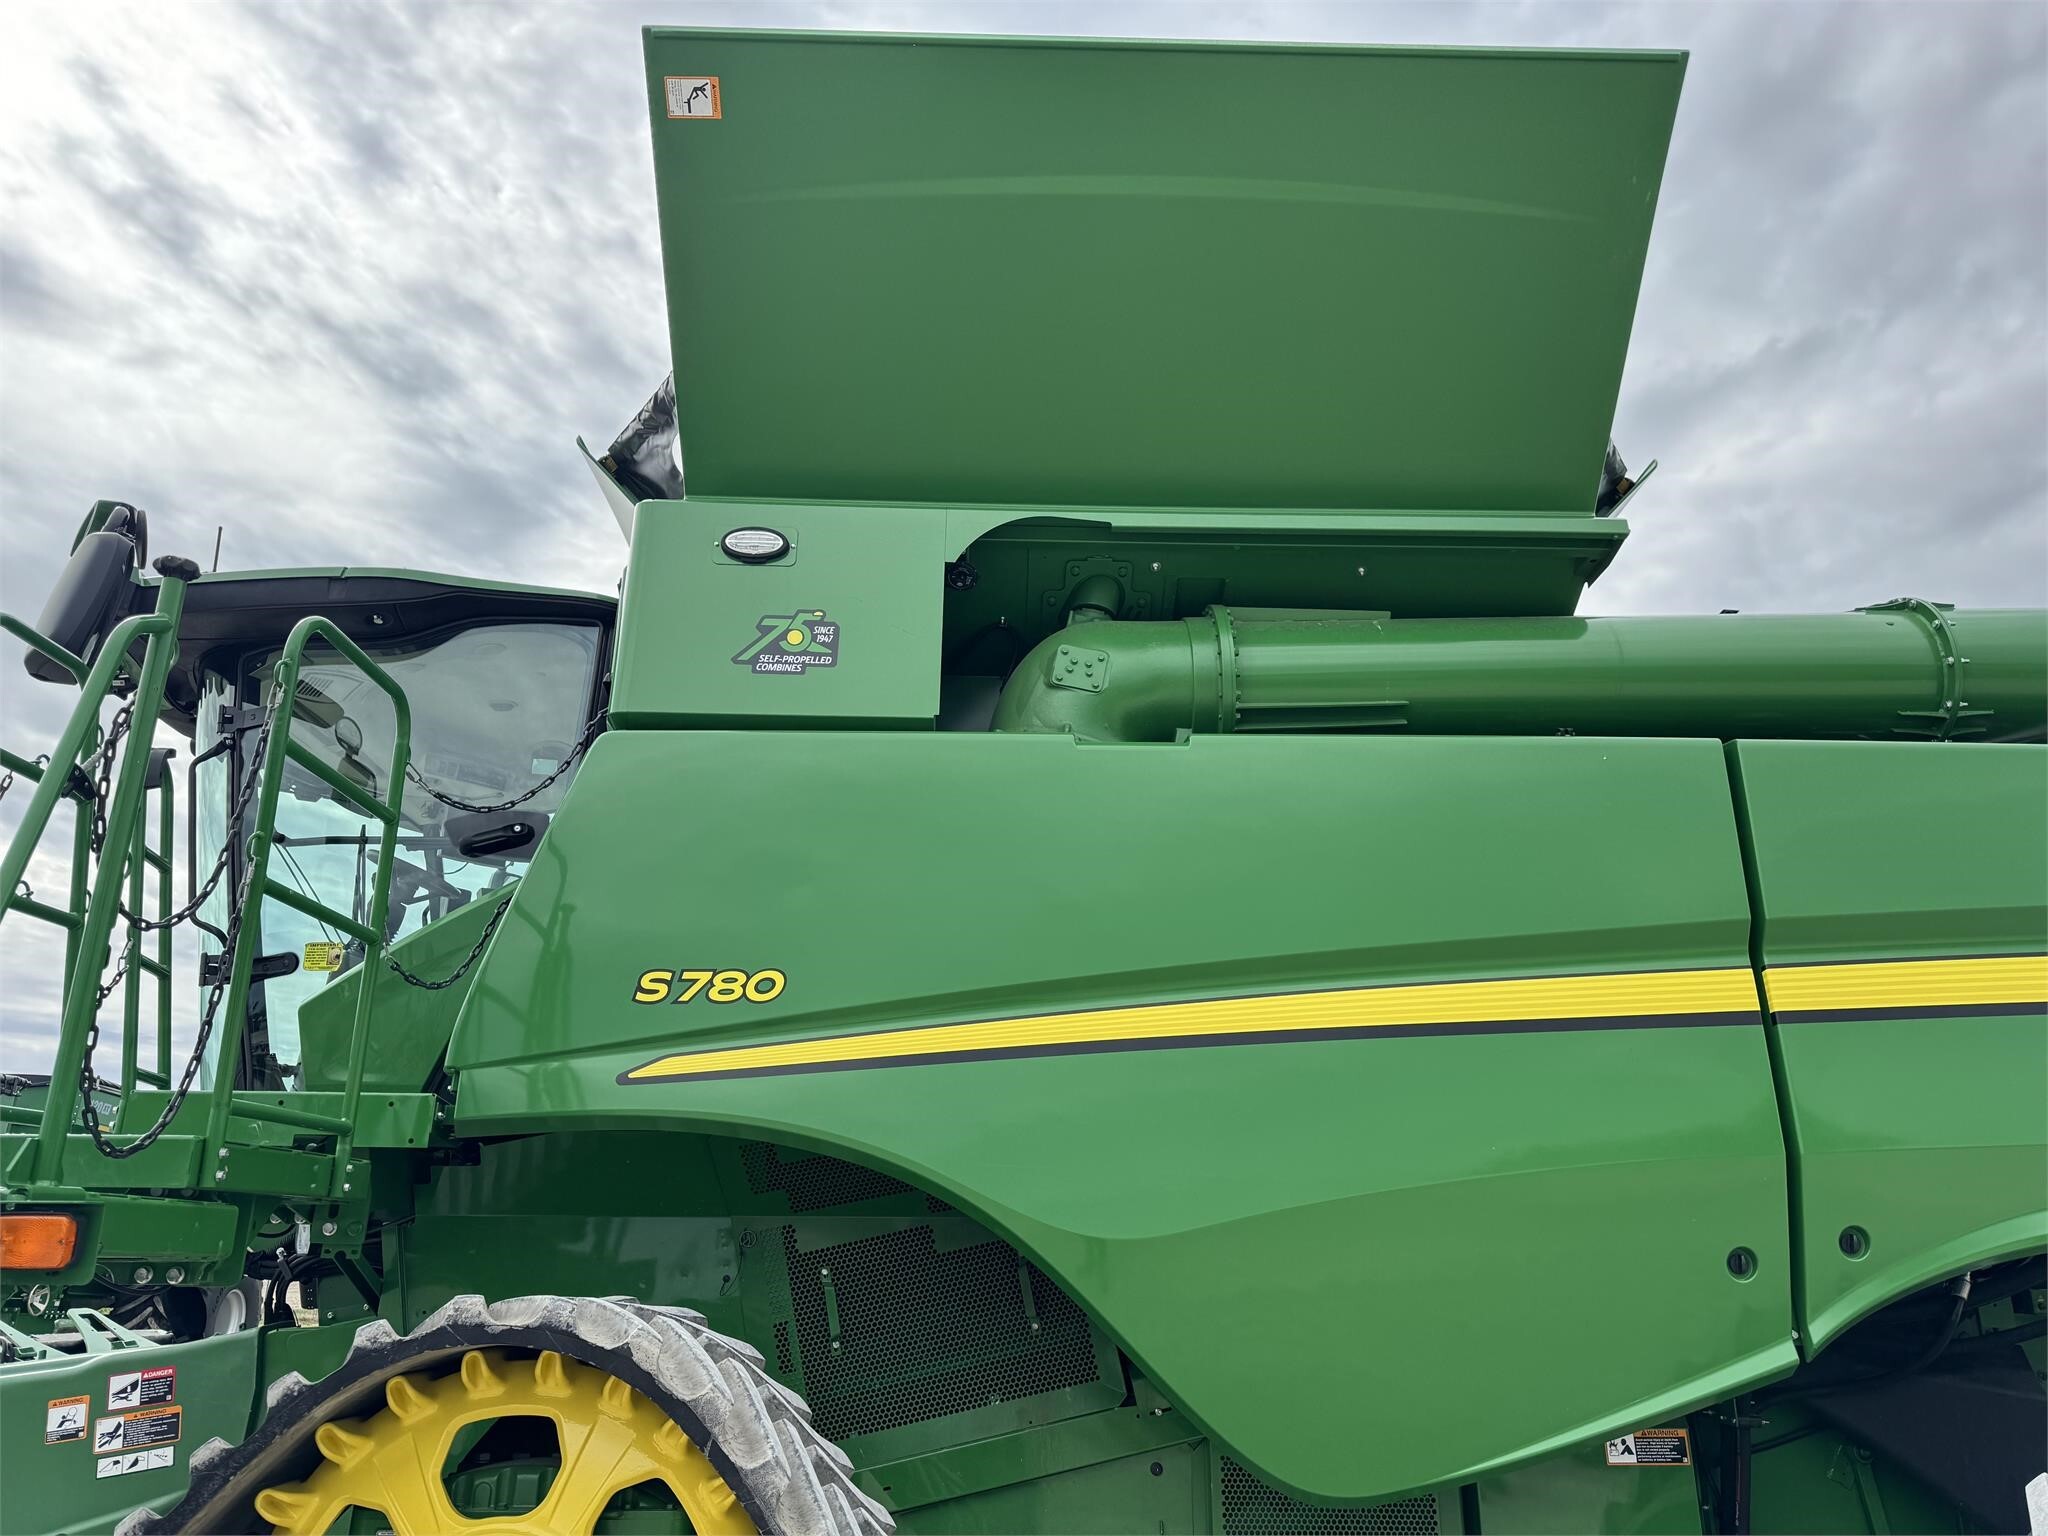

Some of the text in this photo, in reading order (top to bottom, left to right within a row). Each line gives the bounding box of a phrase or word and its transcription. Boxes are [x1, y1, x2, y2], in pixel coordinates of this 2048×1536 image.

[813, 626, 835, 635] SINCE
[816, 635, 834, 643] 1947
[758, 654, 833, 665] SELF-PROPELLED
[756, 663, 803, 672] COMBINES
[633, 969, 786, 1003] S780
[148, 1368, 173, 1378] DANGER
[140, 1408, 167, 1417] WARNING
[1647, 1429, 1679, 1437] WARNING
